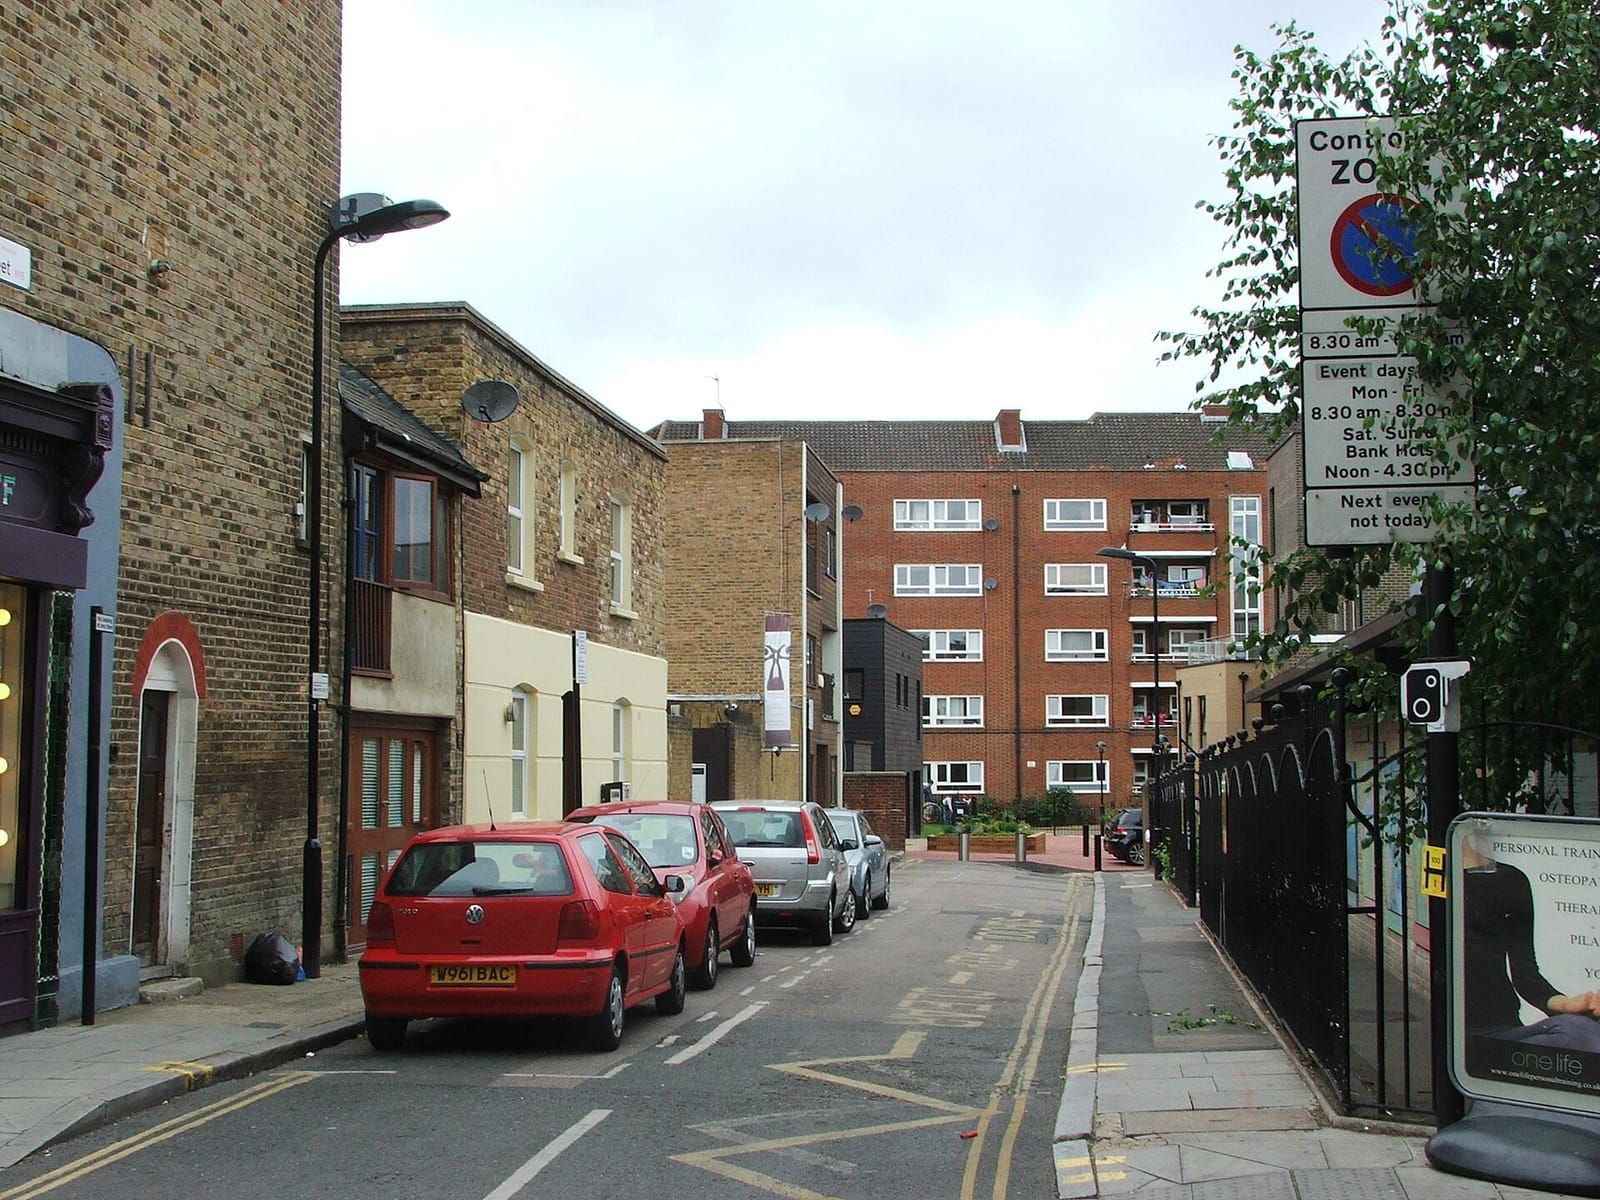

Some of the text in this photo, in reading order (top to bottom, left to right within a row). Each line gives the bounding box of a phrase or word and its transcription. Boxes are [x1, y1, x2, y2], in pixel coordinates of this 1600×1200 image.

[1310, 336, 1350, 349] 8.30
[1355, 337, 1379, 348] am
[1321, 365, 1367, 378] Event
[1377, 364, 1416, 380] days
[1352, 386, 1388, 399] Mon
[1403, 385, 1425, 398] Fri
[1311, 406, 1351, 420] 8.30
[1356, 407, 1380, 419] am
[1396, 404, 1436, 418] 8.30
[1343, 428, 1377, 441] Sat.
[1385, 427, 1419, 440] Sun
[1346, 444, 1434, 458] Bank Hols
[1325, 465, 1369, 478] Noon
[1384, 463, 1426, 477] 4.30
[1341, 494, 1433, 509] Next even
[1351, 514, 1432, 529] not today
[1493, 841, 1558, 857] PERSONAL
[437, 967, 510, 981] W961 BAC
[1512, 1052, 1583, 1076] one life
